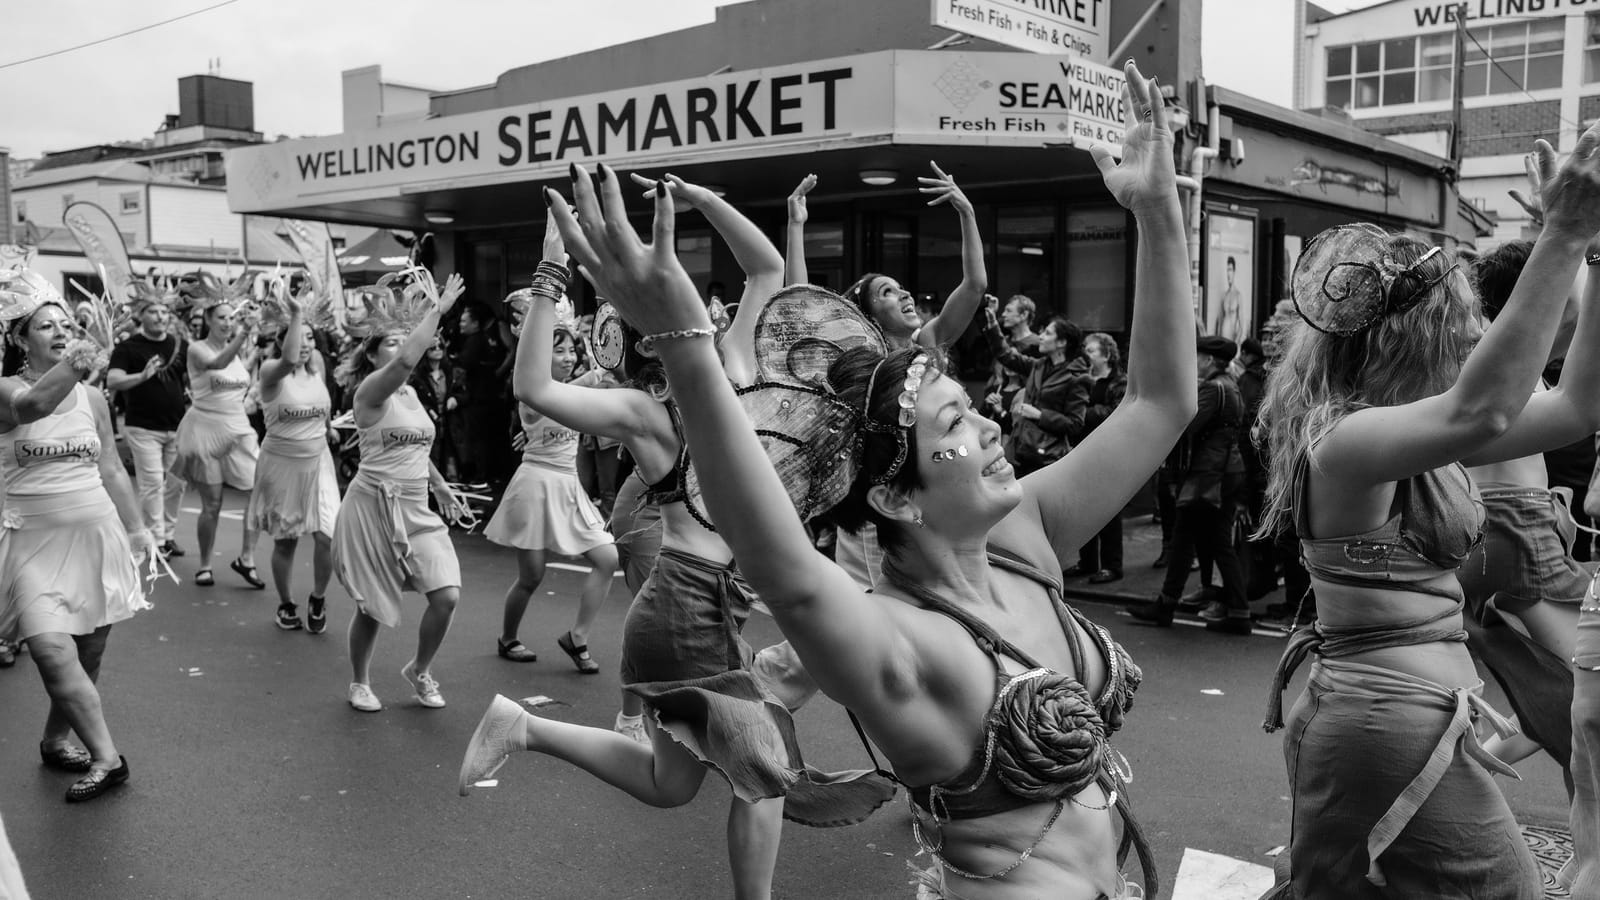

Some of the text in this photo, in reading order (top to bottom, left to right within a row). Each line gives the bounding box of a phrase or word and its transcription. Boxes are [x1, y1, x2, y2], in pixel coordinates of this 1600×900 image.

[950, 0, 1092, 56] Fresh Fish Fish & Chips
[1059, 61, 1126, 92] WELLINGT
[999, 81, 1125, 124] SEAMARKE
[297, 67, 853, 183] WELLINGTON SEAMARKET
[939, 115, 996, 132] Fresh
[1005, 117, 1046, 132] Fish
[1073, 121, 1093, 138] Fish
[1096, 127, 1103, 141] &
[22, 441, 87, 458] Samba
